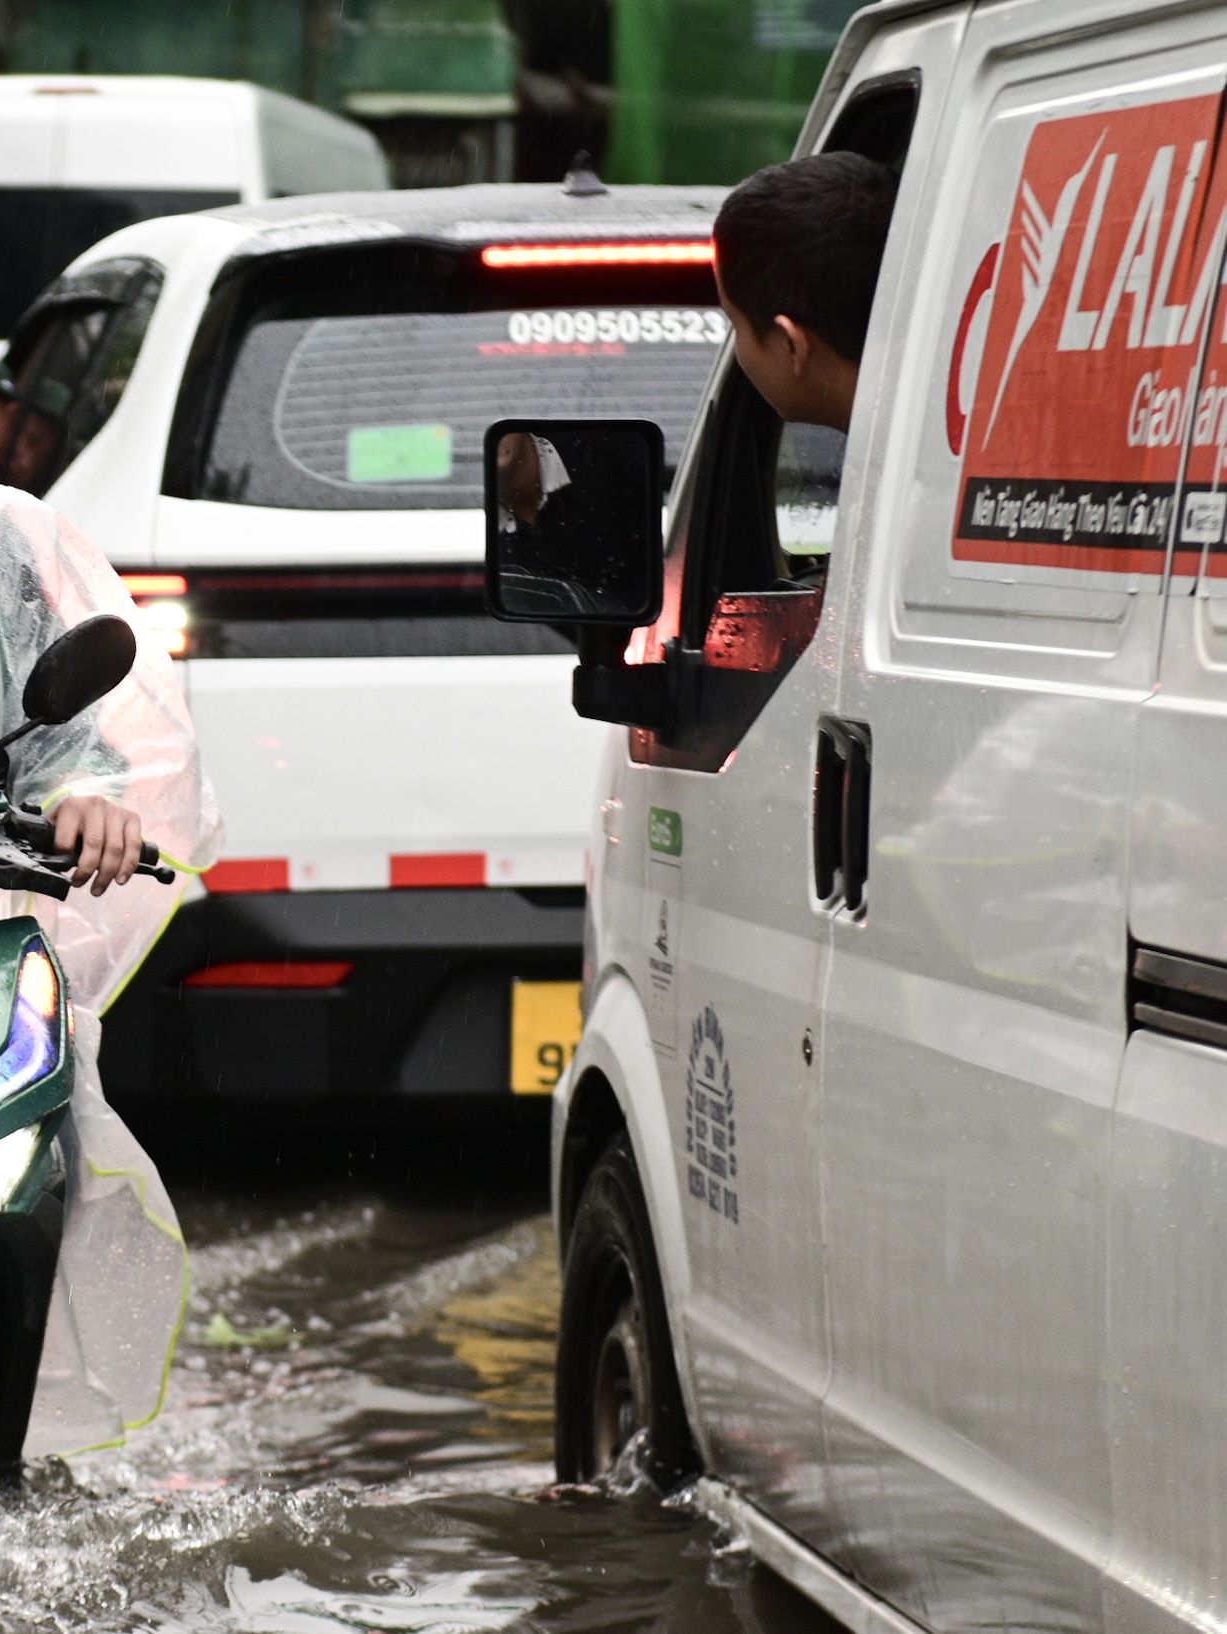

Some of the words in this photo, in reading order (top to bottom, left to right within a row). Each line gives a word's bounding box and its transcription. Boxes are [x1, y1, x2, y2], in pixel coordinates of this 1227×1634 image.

[508, 311, 727, 344] 0909505523
[1127, 369, 1181, 447] Giao
[970, 485, 996, 526] Nền
[1020, 489, 1047, 529] Giao
[1044, 486, 1077, 542] Hàng
[1076, 492, 1106, 533] Theo
[1103, 492, 1127, 534] Yêu
[538, 1042, 577, 1086] 9
